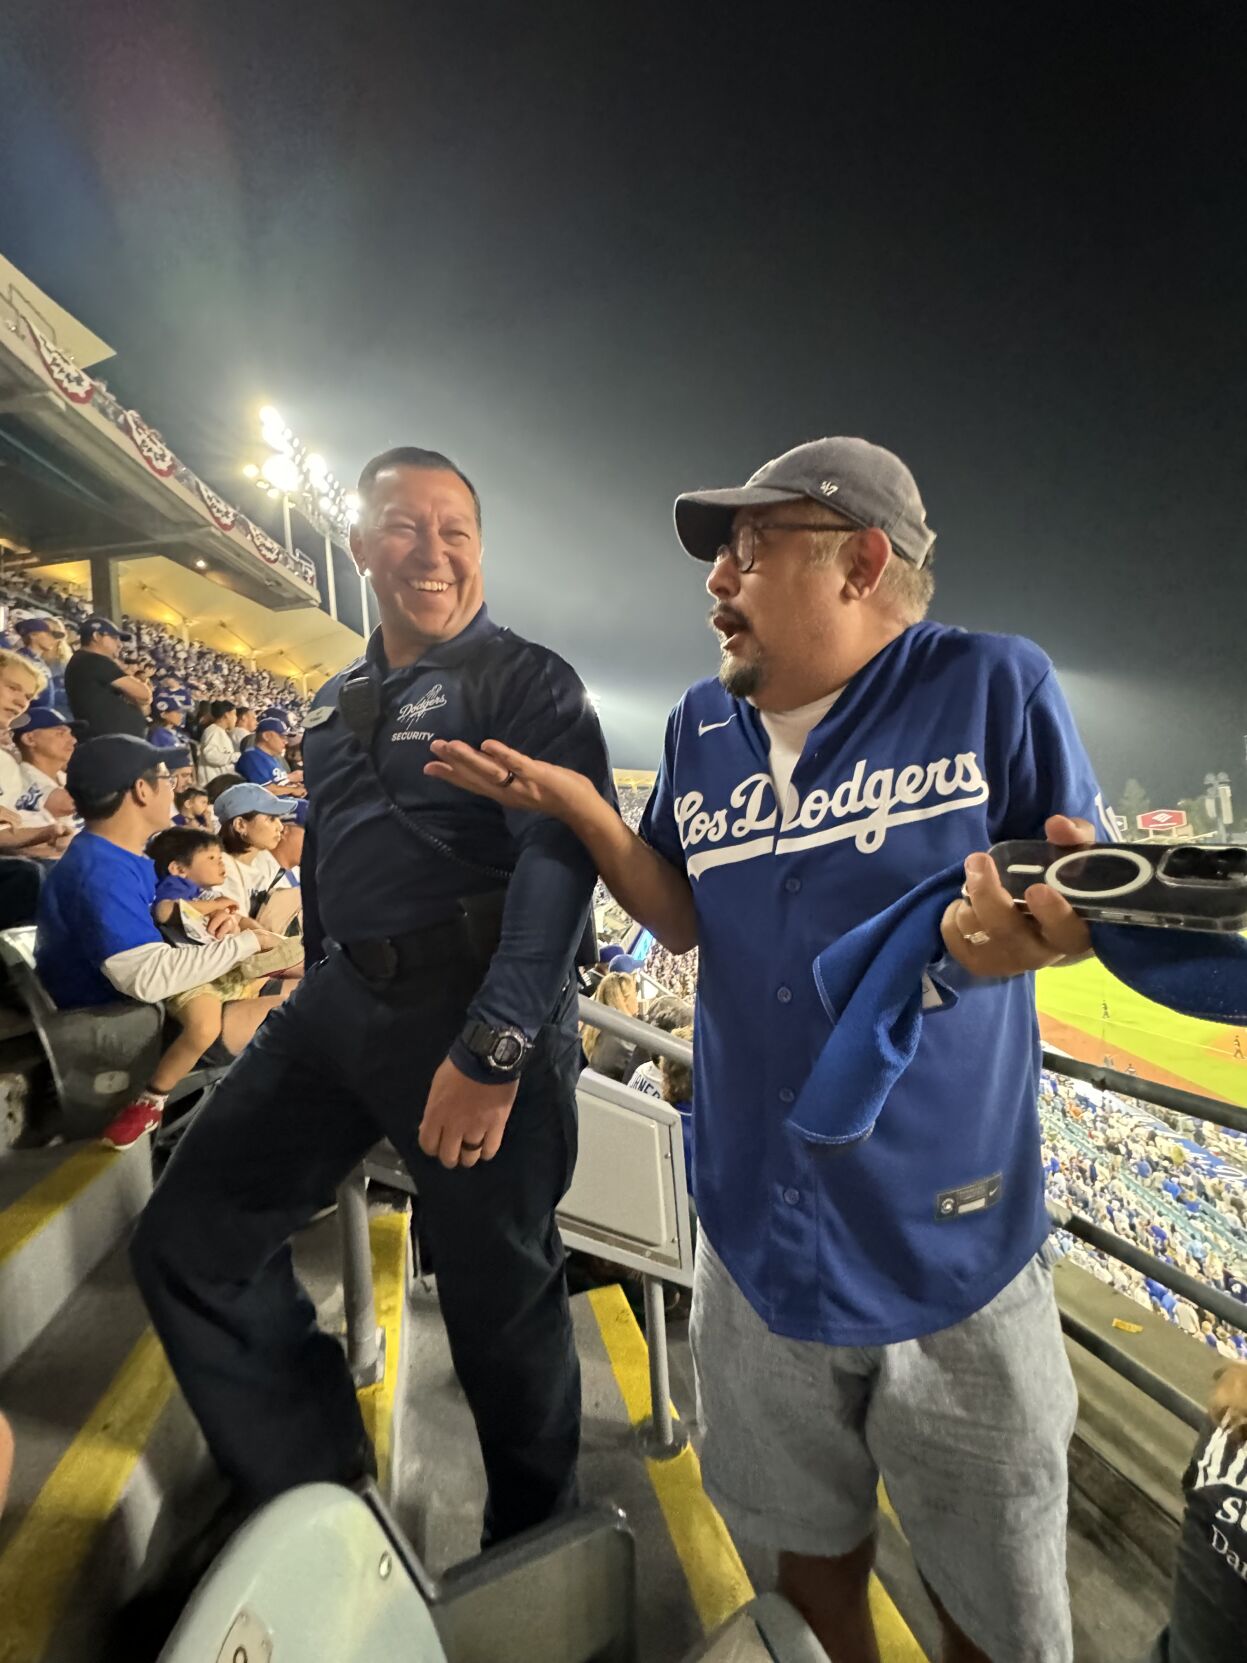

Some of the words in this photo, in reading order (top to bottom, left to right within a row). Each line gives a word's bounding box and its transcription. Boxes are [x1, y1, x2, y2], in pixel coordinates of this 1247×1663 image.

[397, 694, 447, 721] Dodgers
[391, 731, 434, 742] SECURITY
[673, 791, 727, 849] Los
[730, 751, 989, 854] Dodgers
